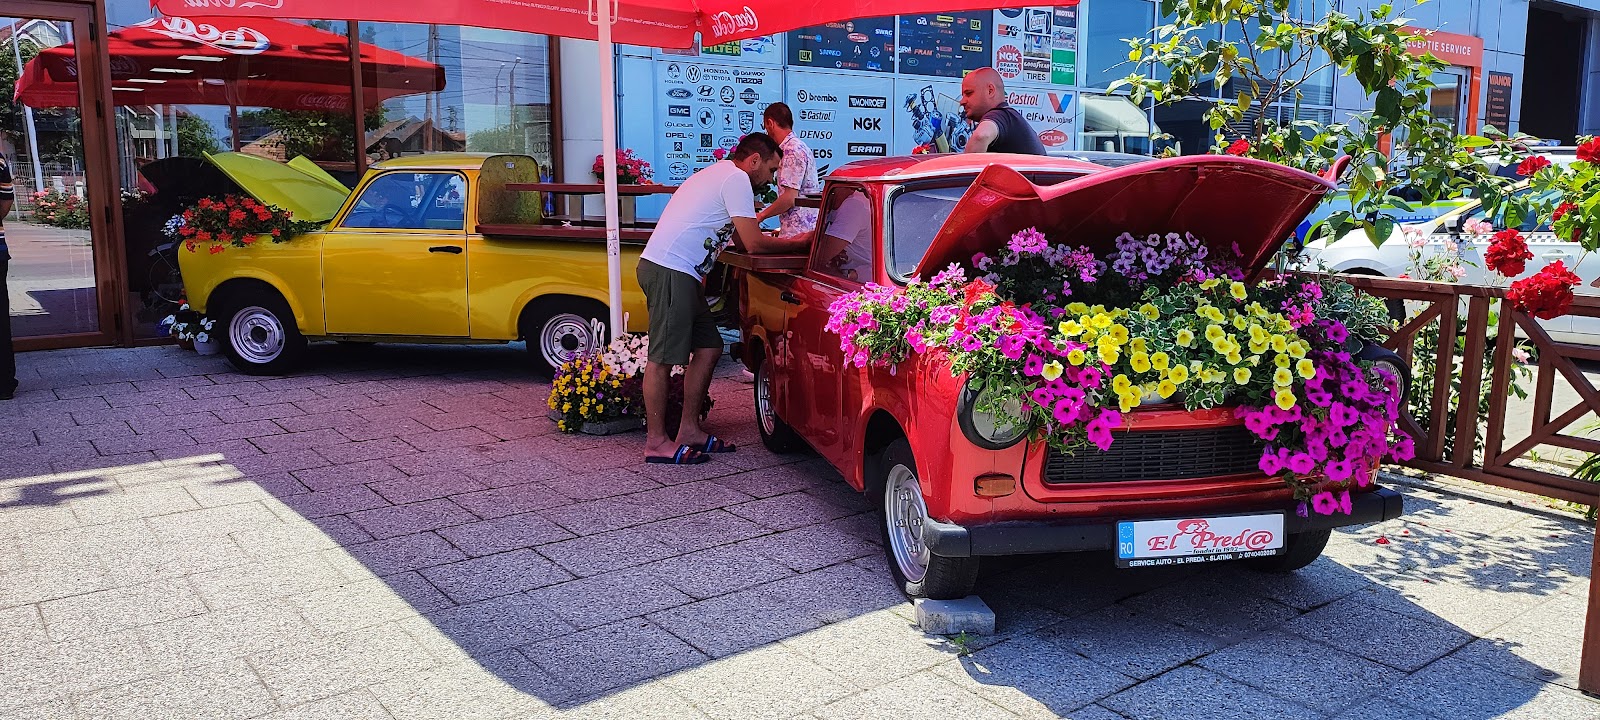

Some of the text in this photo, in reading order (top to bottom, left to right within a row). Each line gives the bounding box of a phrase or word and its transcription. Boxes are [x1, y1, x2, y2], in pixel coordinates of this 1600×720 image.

[1055, 9, 1075, 18] MOTUL
[875, 28, 893, 36] SWAG
[1407, 40, 1471, 56] ECEPTIE SERVICE
[999, 52, 1018, 61] NGK
[1024, 61, 1050, 69] GOODYEAR
[1026, 72, 1046, 80] TIRES
[852, 97, 885, 107] MONROE
[1008, 91, 1039, 106] Castrol
[669, 107, 690, 115] GMC
[807, 111, 831, 120] Castrol
[1026, 112, 1039, 121] elf
[853, 117, 881, 131] NGK
[800, 130, 833, 140] DENSO
[849, 145, 883, 153] SRAM
[812, 149, 833, 159] EOS
[1147, 533, 1177, 551] El
[1120, 542, 1133, 555] RO
[1129, 559, 1155, 567] SERVICE
